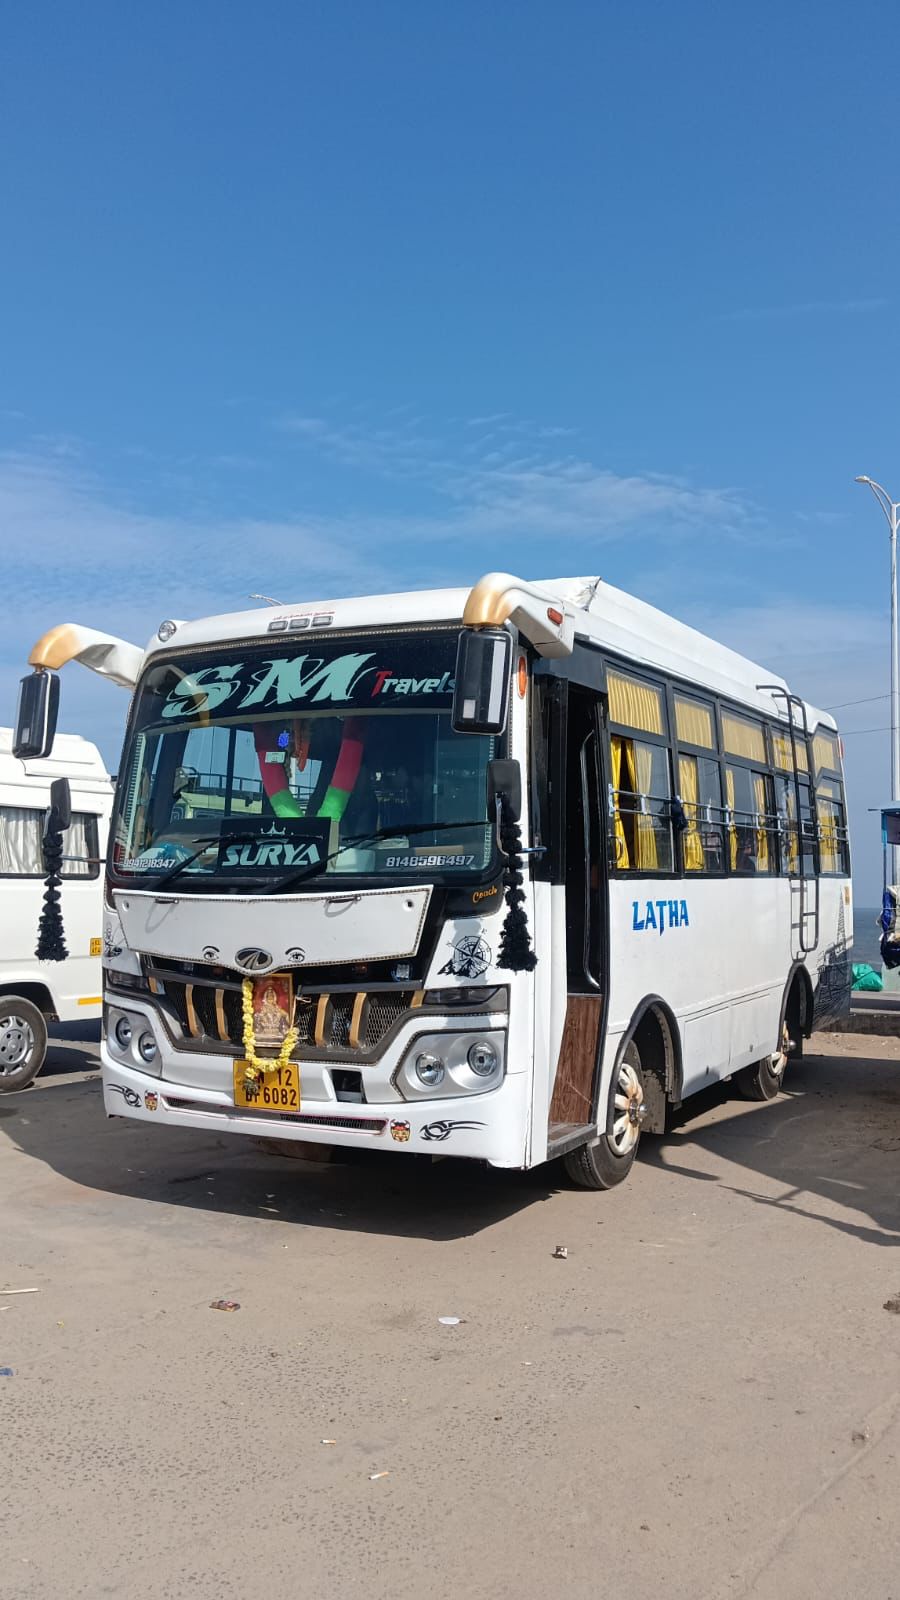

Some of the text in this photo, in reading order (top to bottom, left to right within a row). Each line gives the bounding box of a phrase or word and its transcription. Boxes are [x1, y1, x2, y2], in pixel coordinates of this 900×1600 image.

[371, 670, 456, 696] Travels
[221, 844, 321, 866] SURYA
[385, 855, 475, 867] 8148596497
[632, 899, 689, 937] LATHA
[277, 1068, 292, 1087] 12
